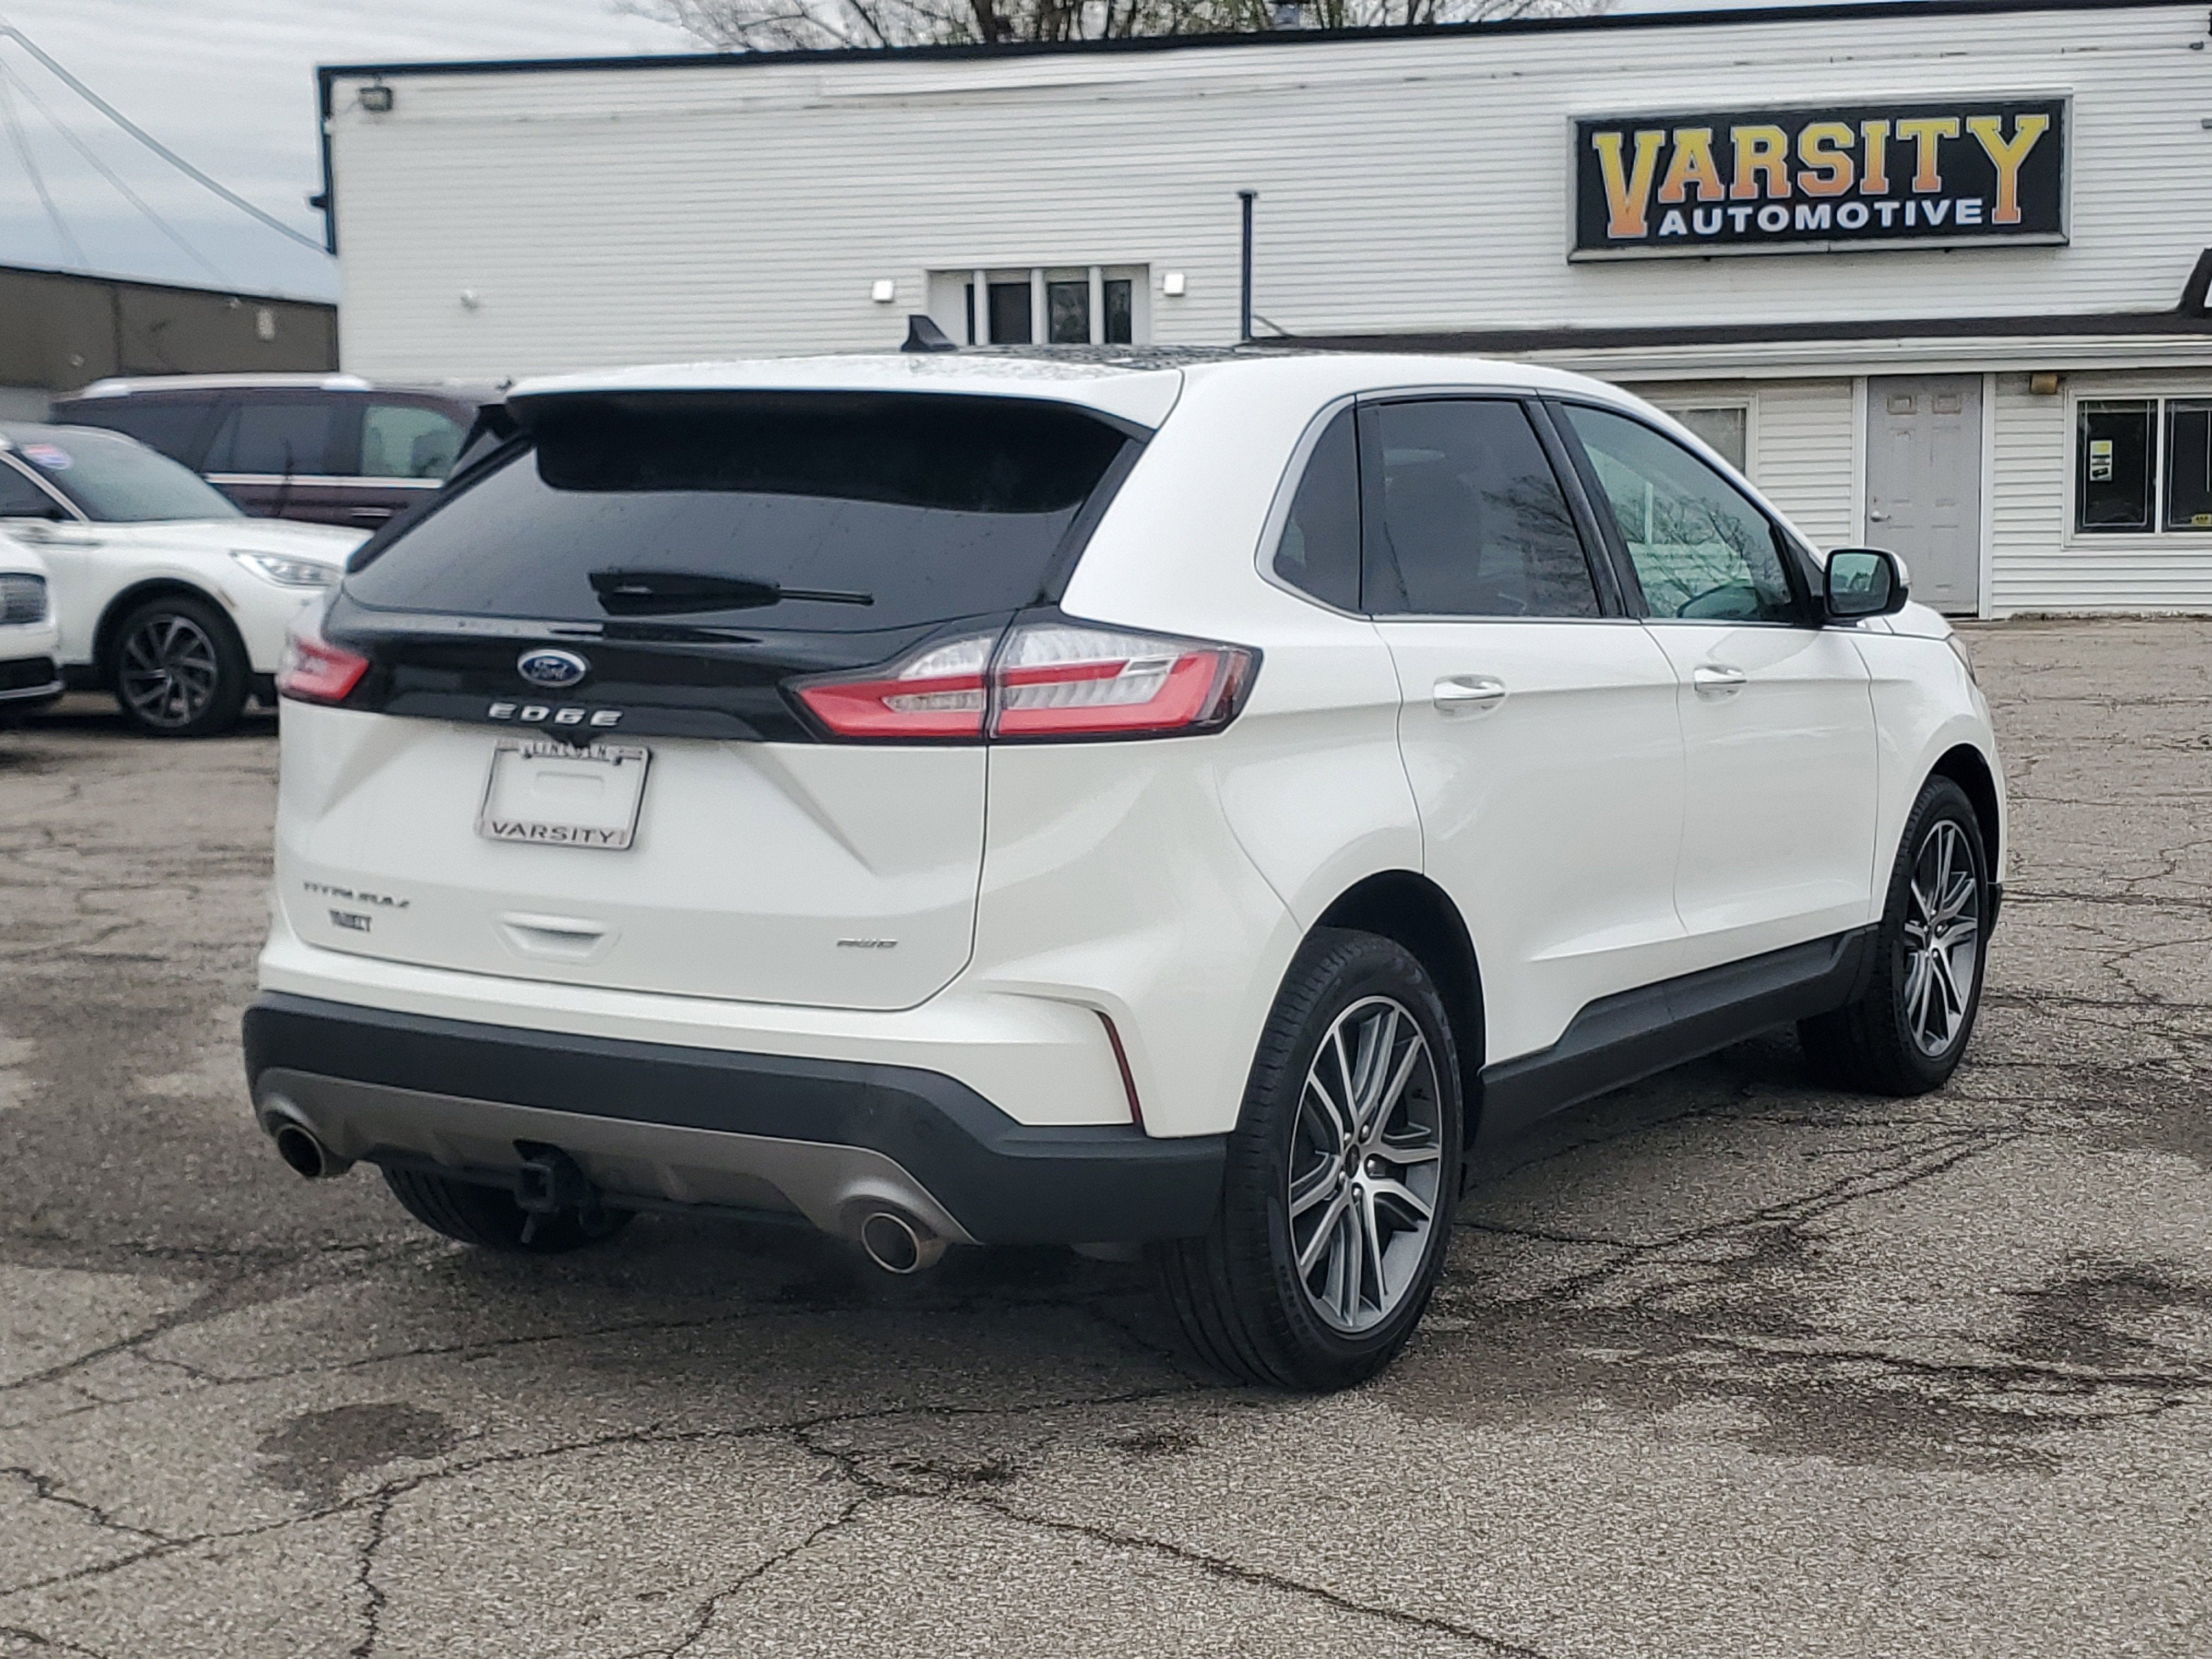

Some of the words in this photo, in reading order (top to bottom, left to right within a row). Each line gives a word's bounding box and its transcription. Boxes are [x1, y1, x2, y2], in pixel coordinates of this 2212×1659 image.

[1592, 114, 2050, 239] VARSITY
[1658, 198, 1983, 236] AUTOMOTIVE
[489, 703, 623, 726] EDGE
[532, 741, 607, 759] LINCLN
[492, 821, 615, 844] VARSITY
